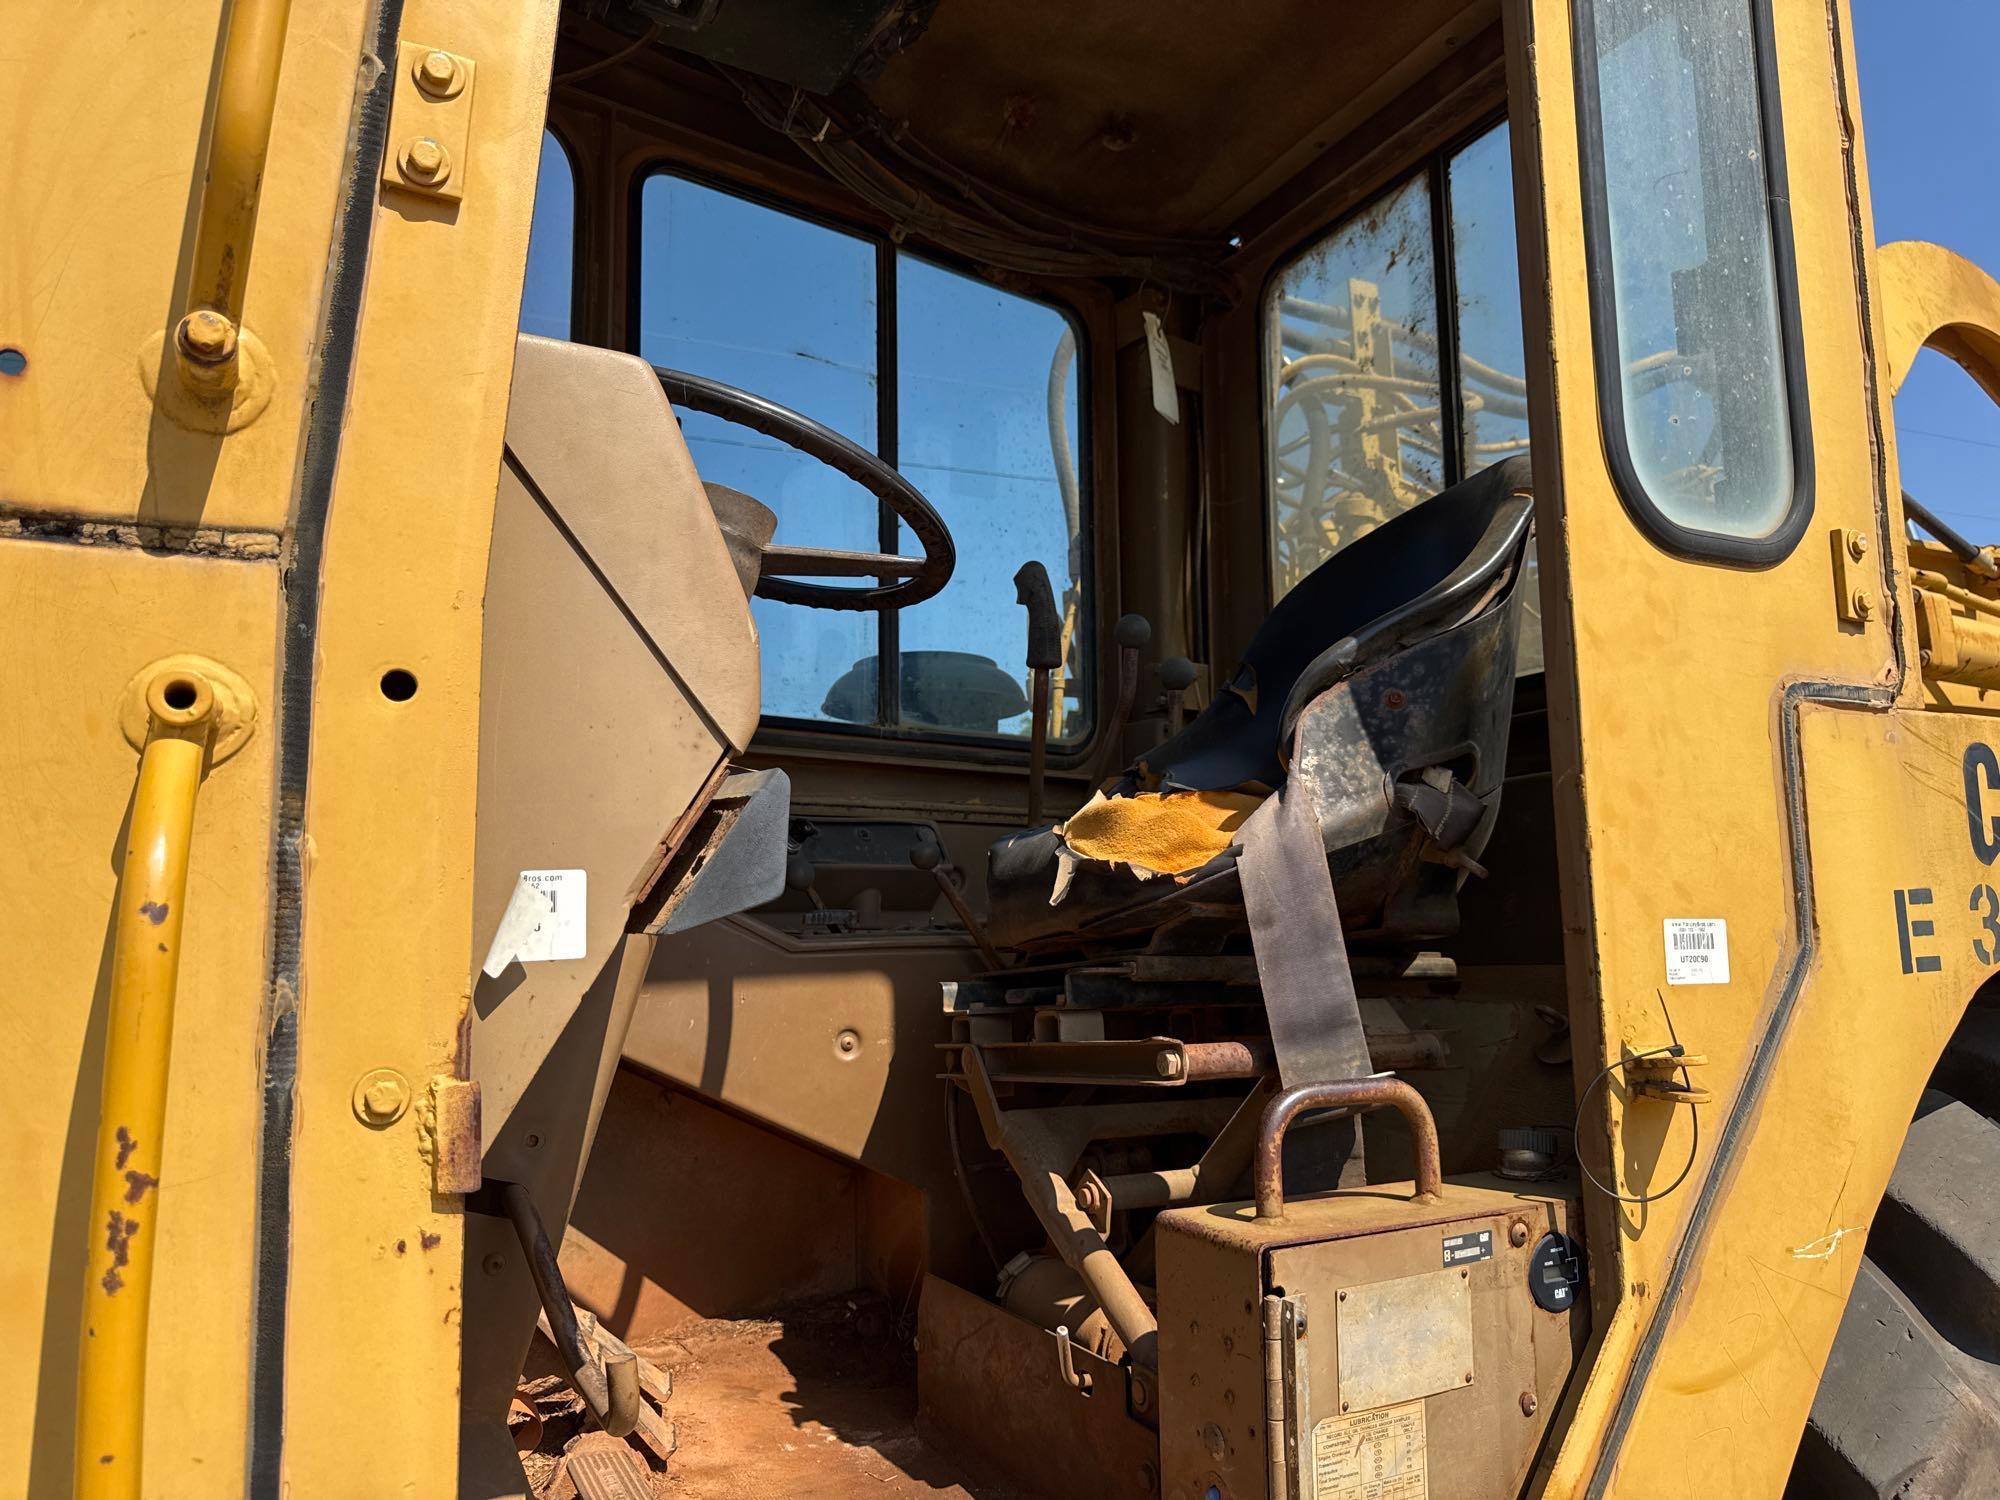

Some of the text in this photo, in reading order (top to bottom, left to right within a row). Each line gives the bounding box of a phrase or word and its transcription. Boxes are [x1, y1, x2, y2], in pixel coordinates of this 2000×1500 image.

[1894, 884, 2000, 974] E 3
[1349, 1412, 1389, 1427] LUBRICATION
